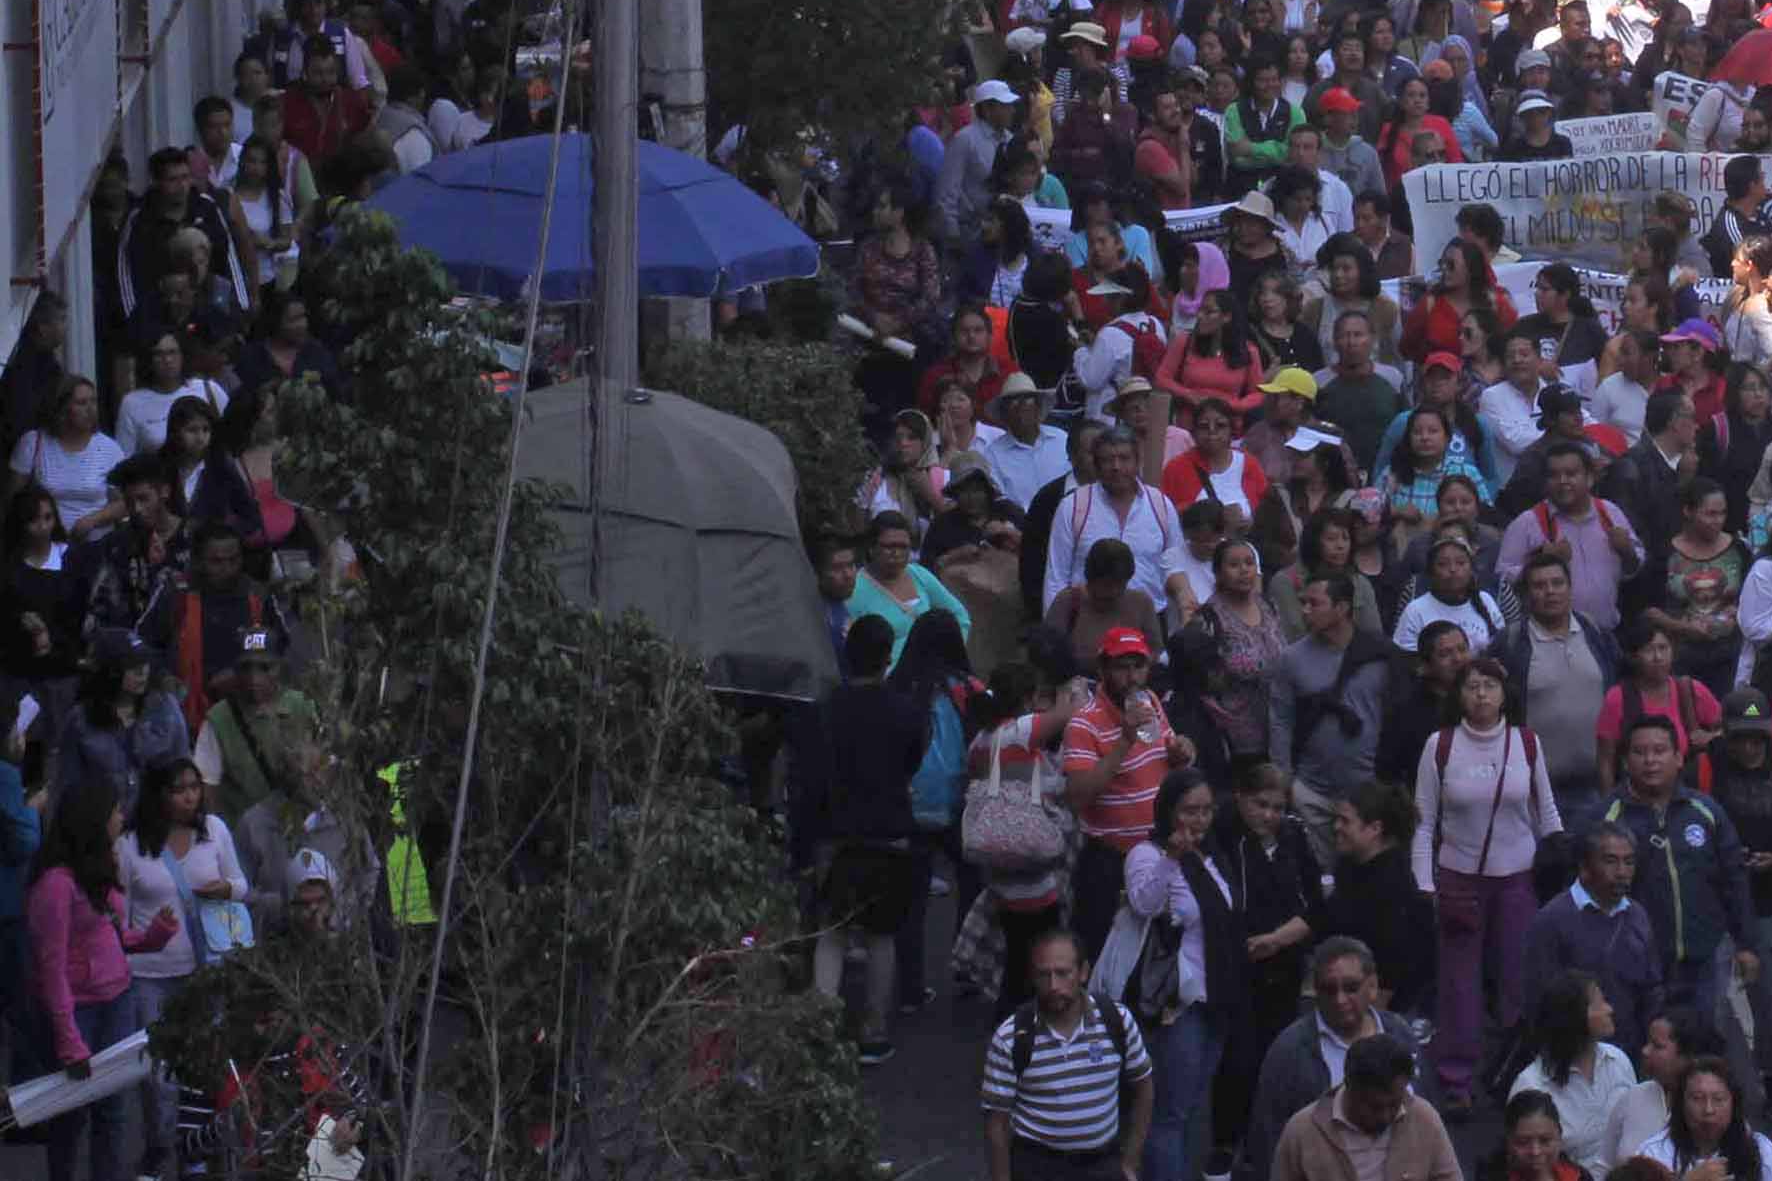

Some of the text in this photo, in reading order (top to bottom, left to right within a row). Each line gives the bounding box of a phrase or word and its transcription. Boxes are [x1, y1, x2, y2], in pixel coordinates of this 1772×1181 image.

[1424, 161, 1500, 204] LLEGÓ
[1509, 167, 1539, 200] EL
[1545, 156, 1622, 196] HORROR
[1626, 155, 1652, 192] DE
[1660, 153, 1688, 192] LA
